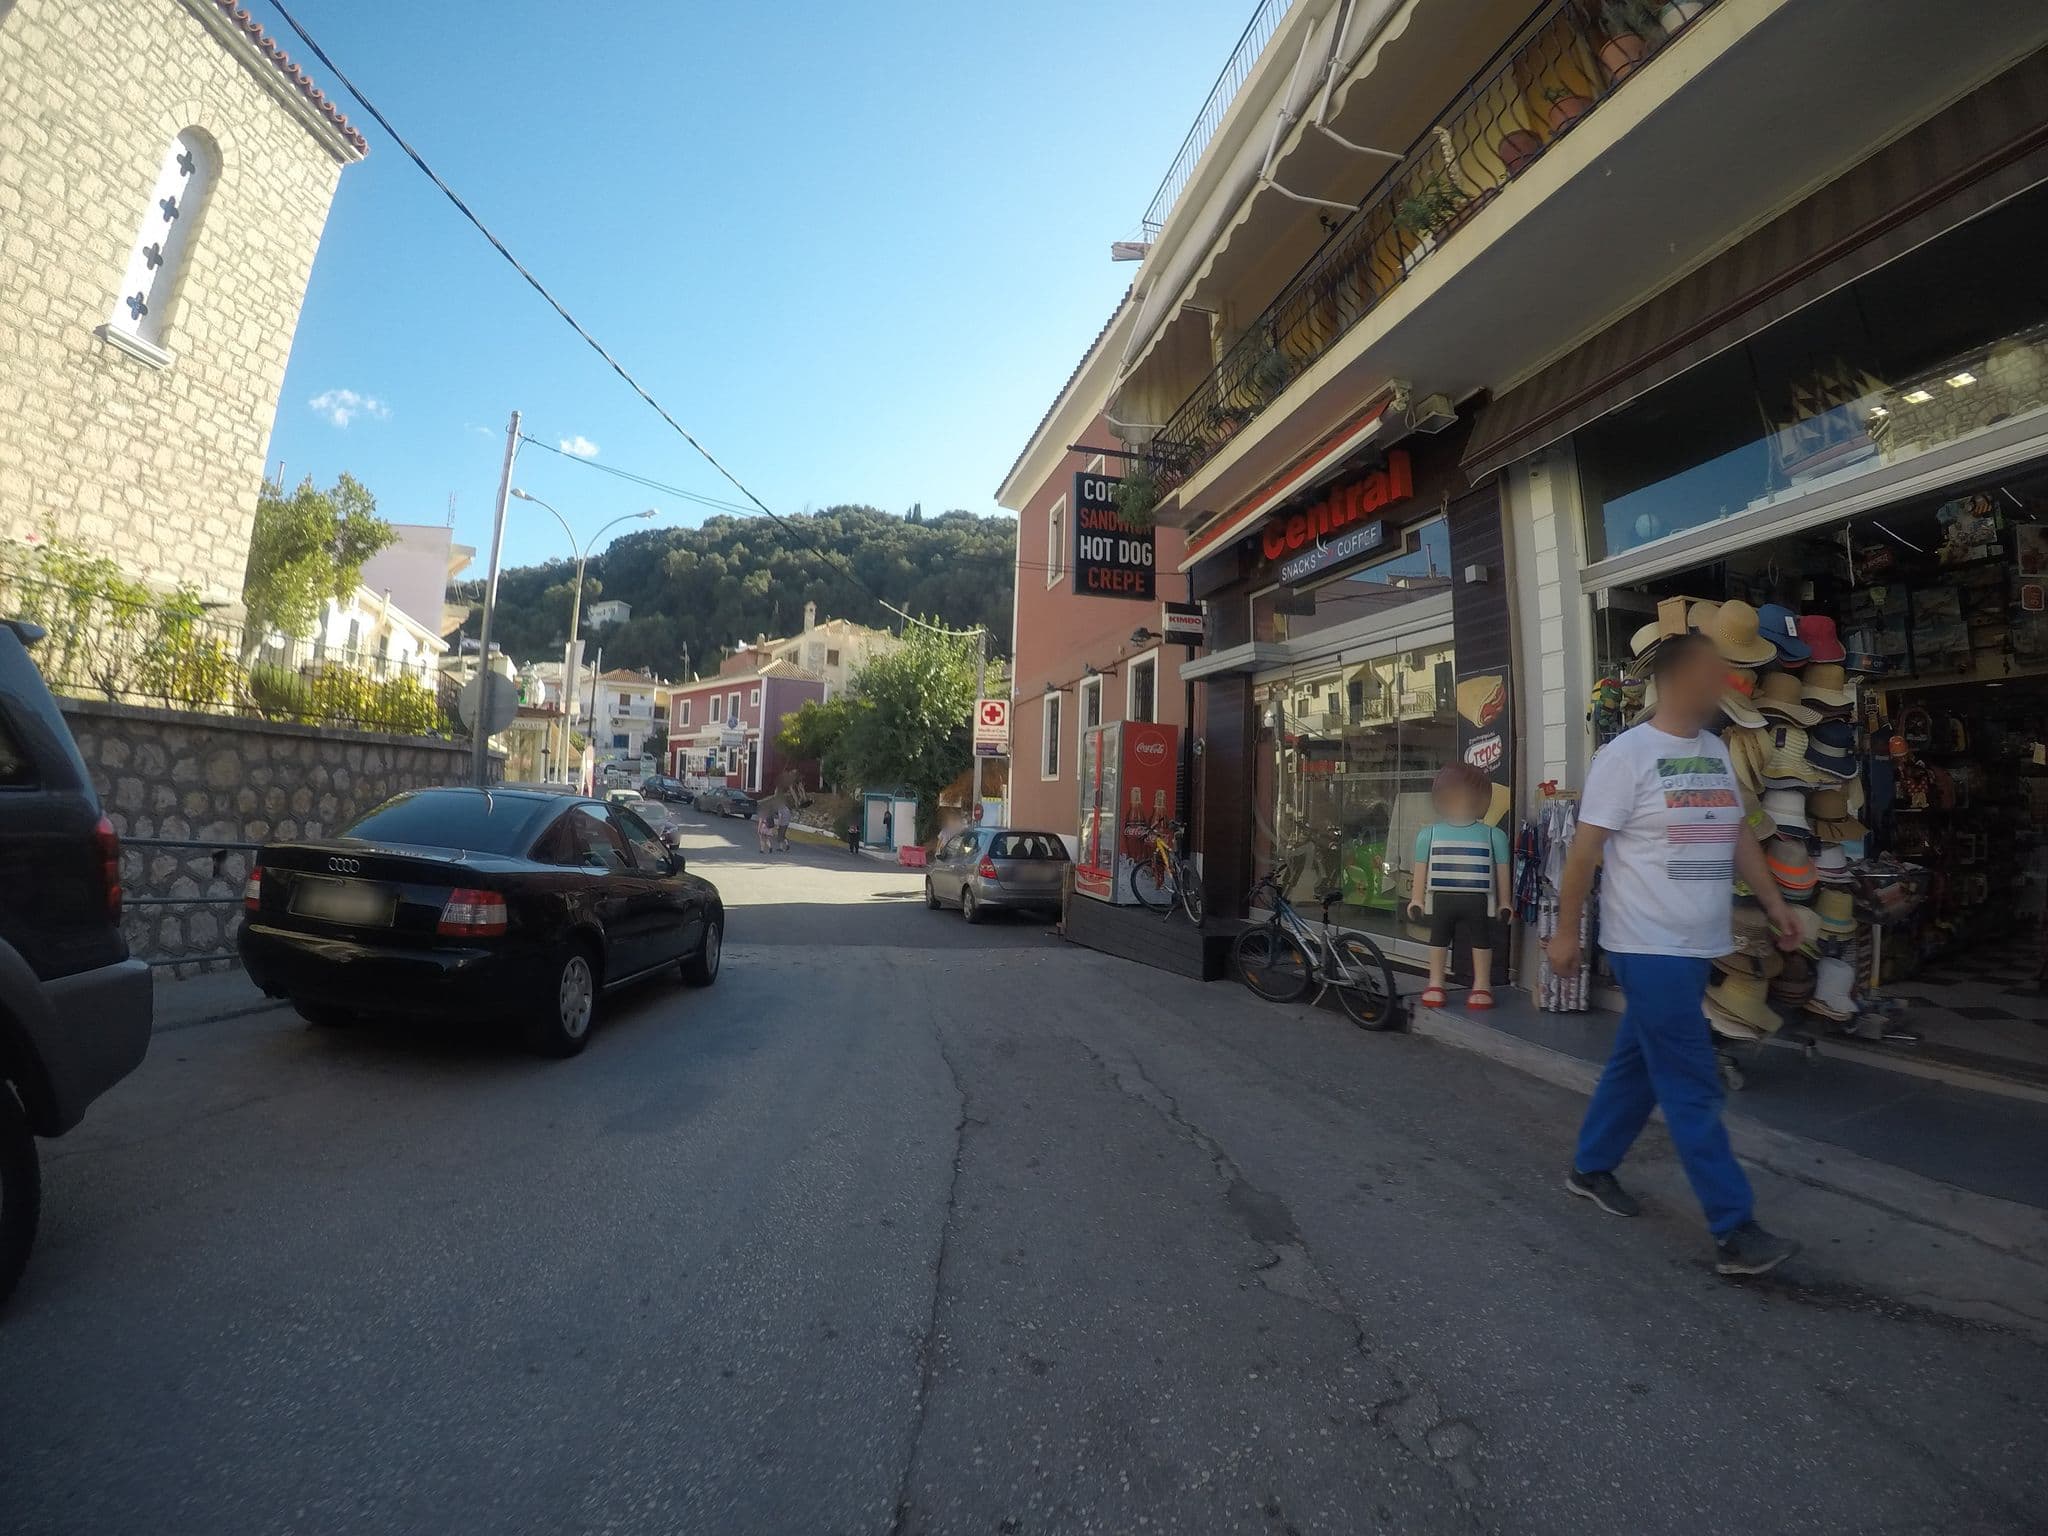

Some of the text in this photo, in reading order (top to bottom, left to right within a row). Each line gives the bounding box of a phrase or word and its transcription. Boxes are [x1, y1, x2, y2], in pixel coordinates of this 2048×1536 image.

[1080, 535, 1153, 567] HOT DOG
[1281, 527, 1377, 581] SNACKS COFFEE
[1088, 567, 1145, 592] CREPE
[1168, 615, 1201, 625] KIMBO
